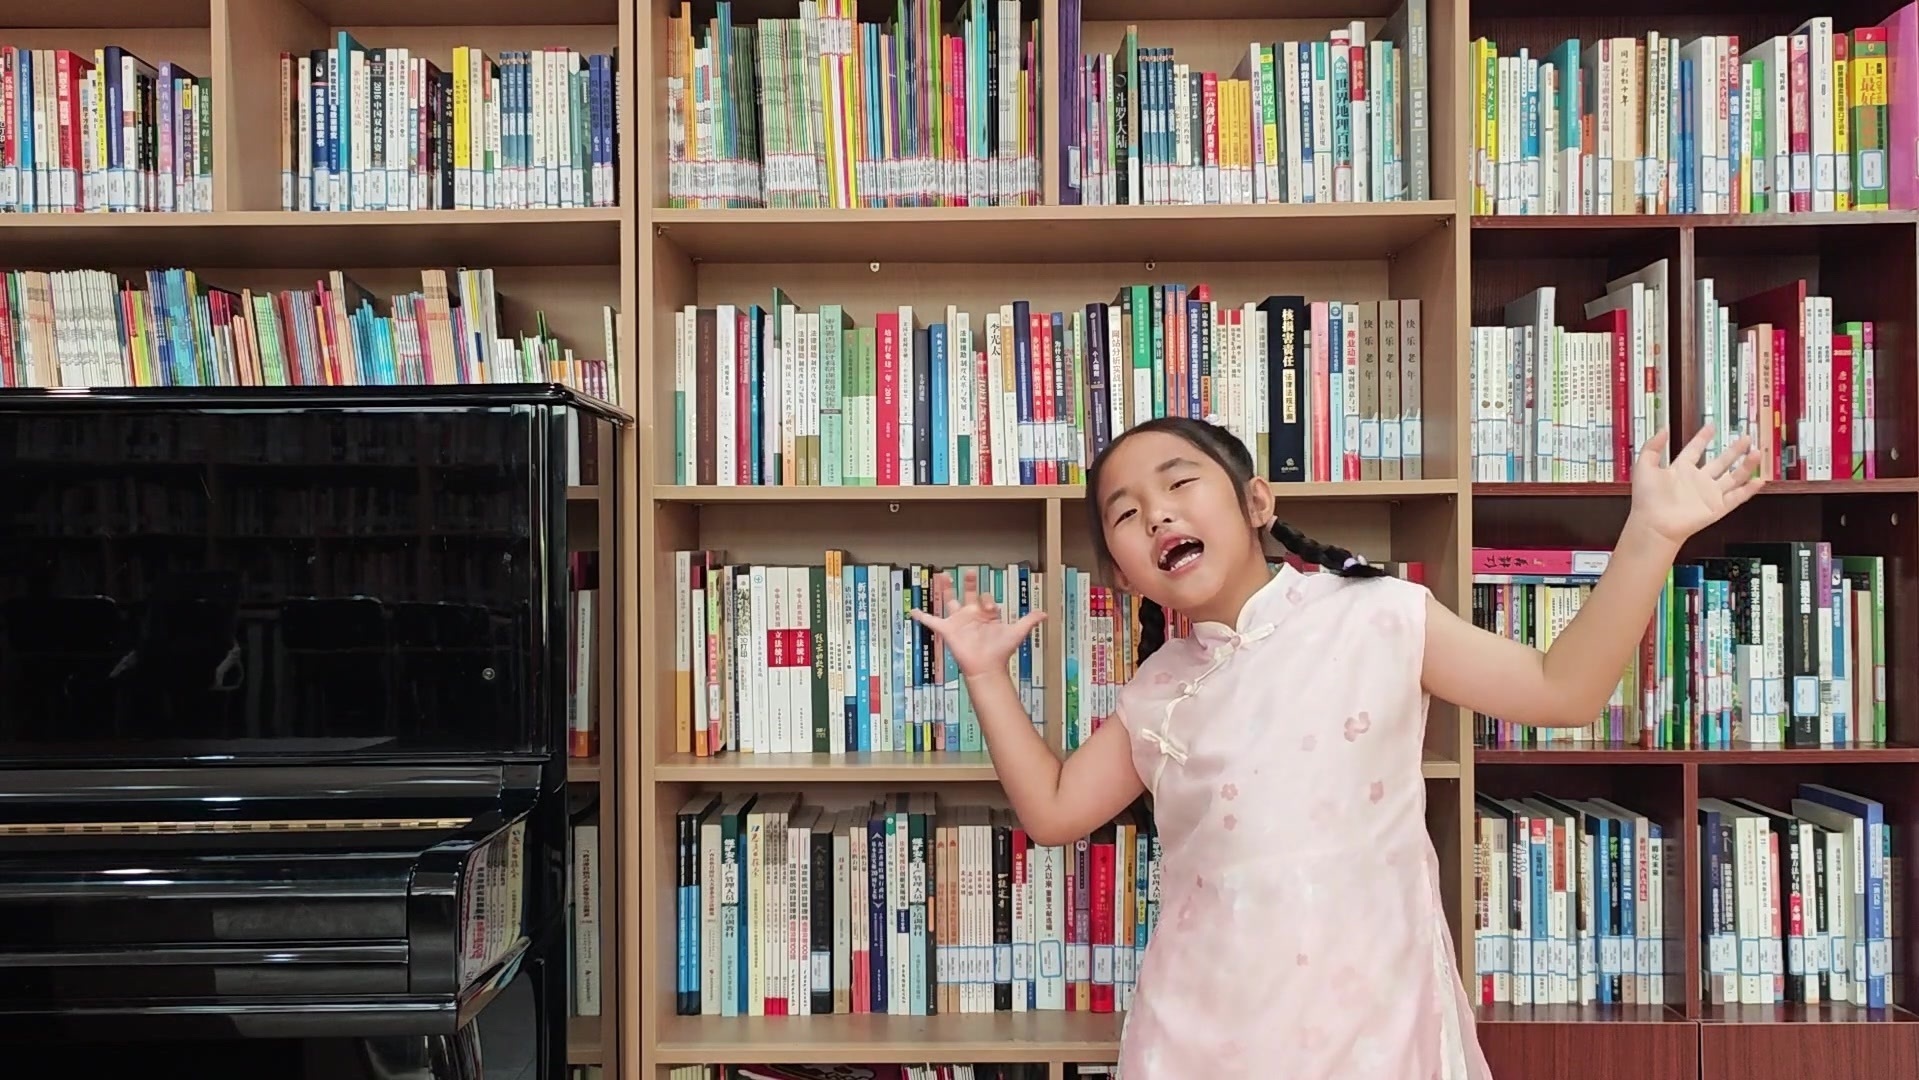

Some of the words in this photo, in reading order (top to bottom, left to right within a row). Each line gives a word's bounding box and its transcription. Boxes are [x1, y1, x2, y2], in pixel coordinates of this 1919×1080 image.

[1116, 92, 1127, 149] 斗罗大陆
[1336, 79, 1349, 158] 世界地理百科
[1282, 308, 1295, 368] 核损害责任
[1364, 319, 1374, 380] 快乐老年
[1385, 319, 1394, 380] 快乐老年
[1406, 319, 1416, 380] 快乐老年
[774, 631, 783, 665] 立法统计
[796, 631, 805, 664] 立法统计
